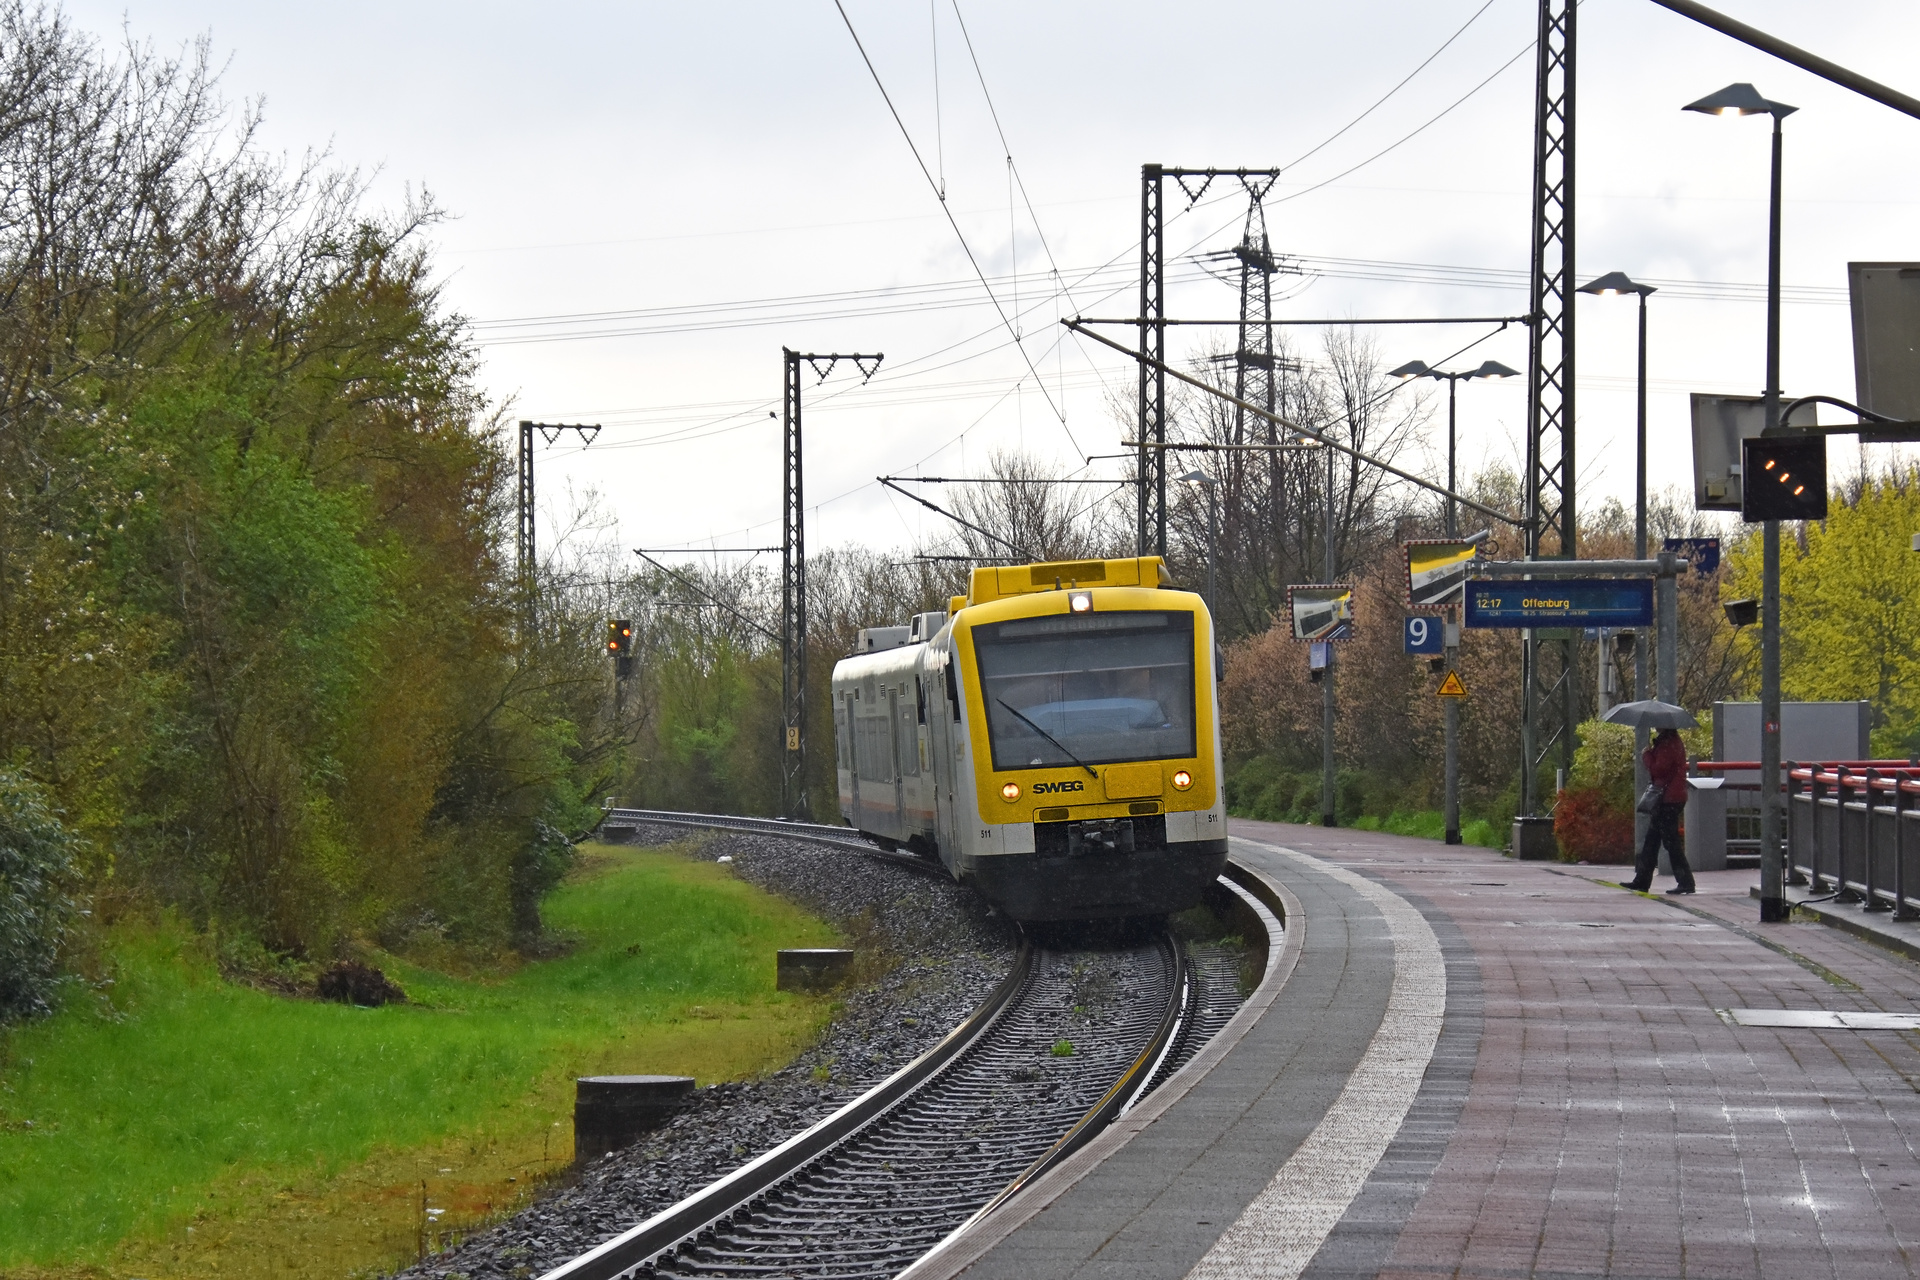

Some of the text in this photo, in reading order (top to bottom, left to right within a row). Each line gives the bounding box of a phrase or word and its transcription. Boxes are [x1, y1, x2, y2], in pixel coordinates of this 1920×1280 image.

[1476, 598, 1570, 610] 12:17 Offenburg
[1409, 617, 1428, 646] 9
[1033, 780, 1084, 795] SWEG
[1208, 813, 1218, 823] 511
[981, 829, 991, 839] 511
